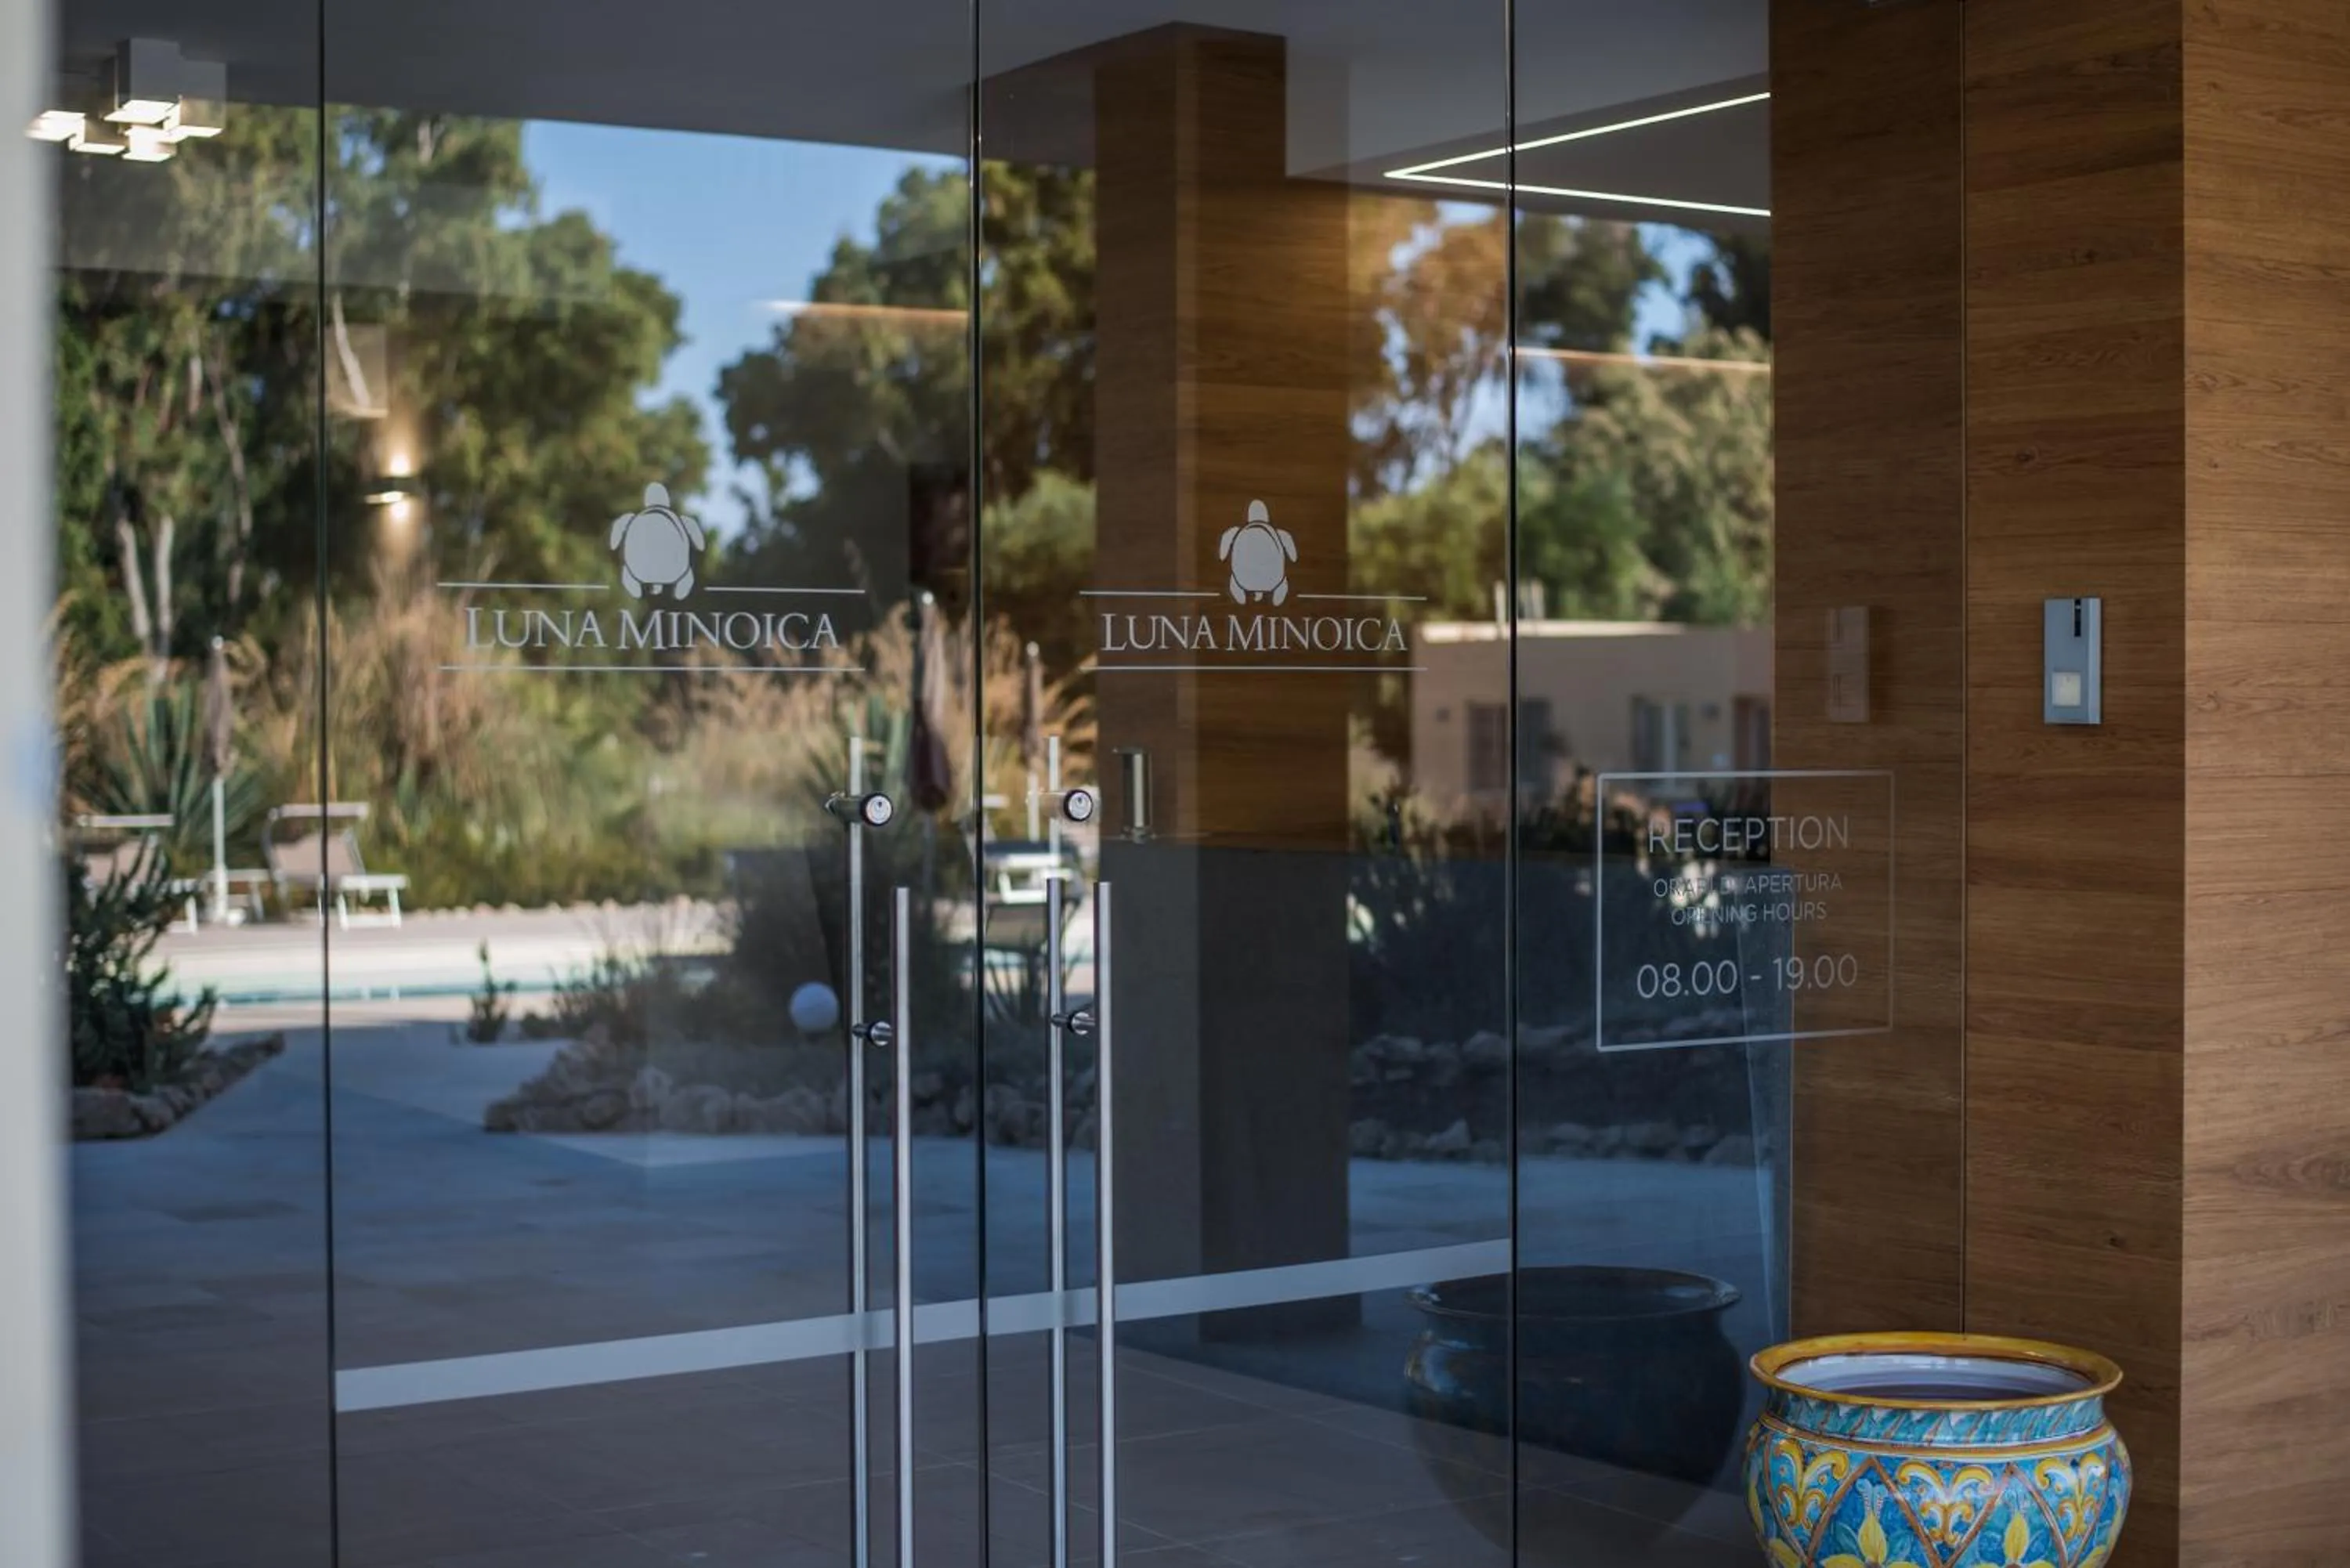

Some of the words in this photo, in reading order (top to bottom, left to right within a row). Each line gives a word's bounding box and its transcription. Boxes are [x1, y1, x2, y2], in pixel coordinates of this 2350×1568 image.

[465, 607, 607, 650] LUNA
[615, 608, 840, 651] MINOICA
[1101, 613, 1219, 652] LUNA
[1225, 614, 1408, 652] MINOICA
[1648, 815, 1849, 854] RECEPTION
[1745, 873, 1843, 895] APERTURA
[1762, 901, 1828, 923] HOURS
[1636, 959, 1738, 999] 08.00
[1772, 953, 1858, 991] 19.00
